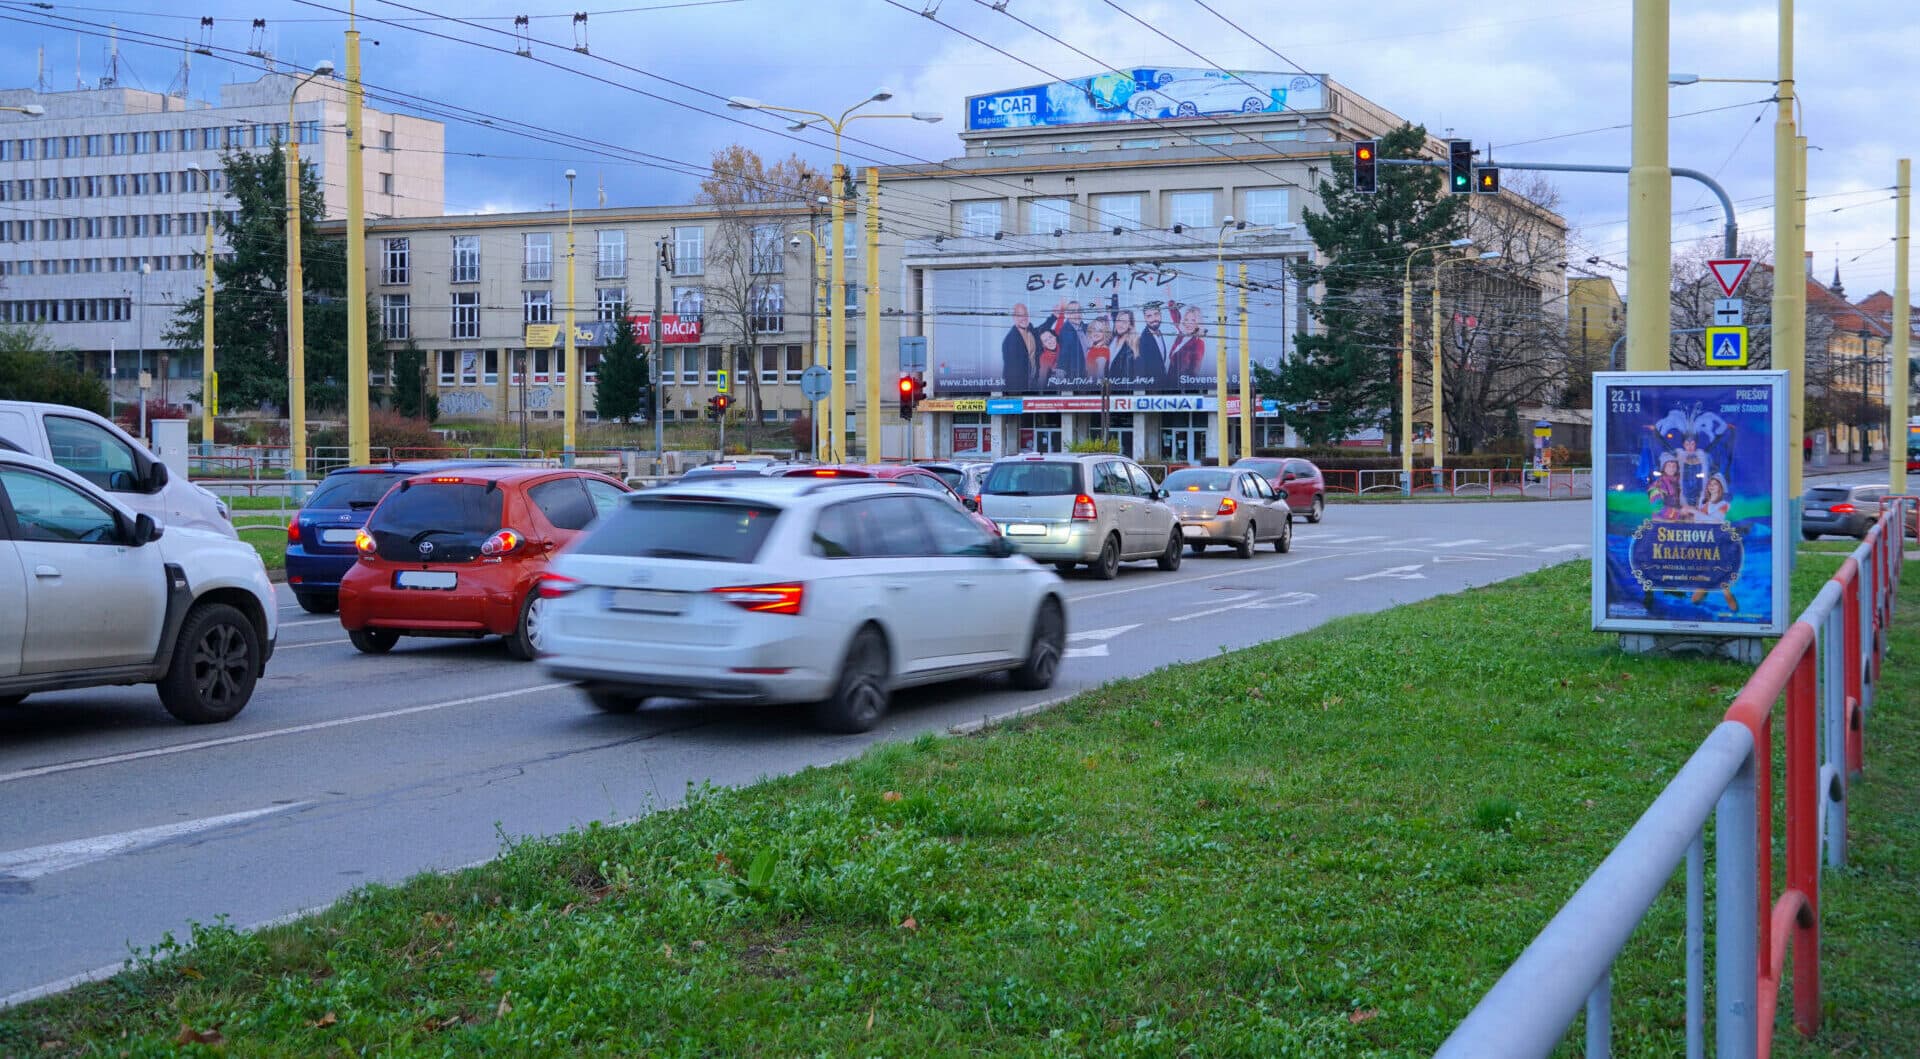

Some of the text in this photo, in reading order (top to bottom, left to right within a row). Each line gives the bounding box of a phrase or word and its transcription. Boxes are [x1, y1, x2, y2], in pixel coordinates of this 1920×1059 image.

[939, 377, 1006, 386] www.benard.sk
[1114, 398, 1132, 410] RI
[1136, 398, 1192, 410] OKNA
[1612, 403, 1641, 413] 2023
[1657, 527, 1715, 543] SNEHOVÁ
